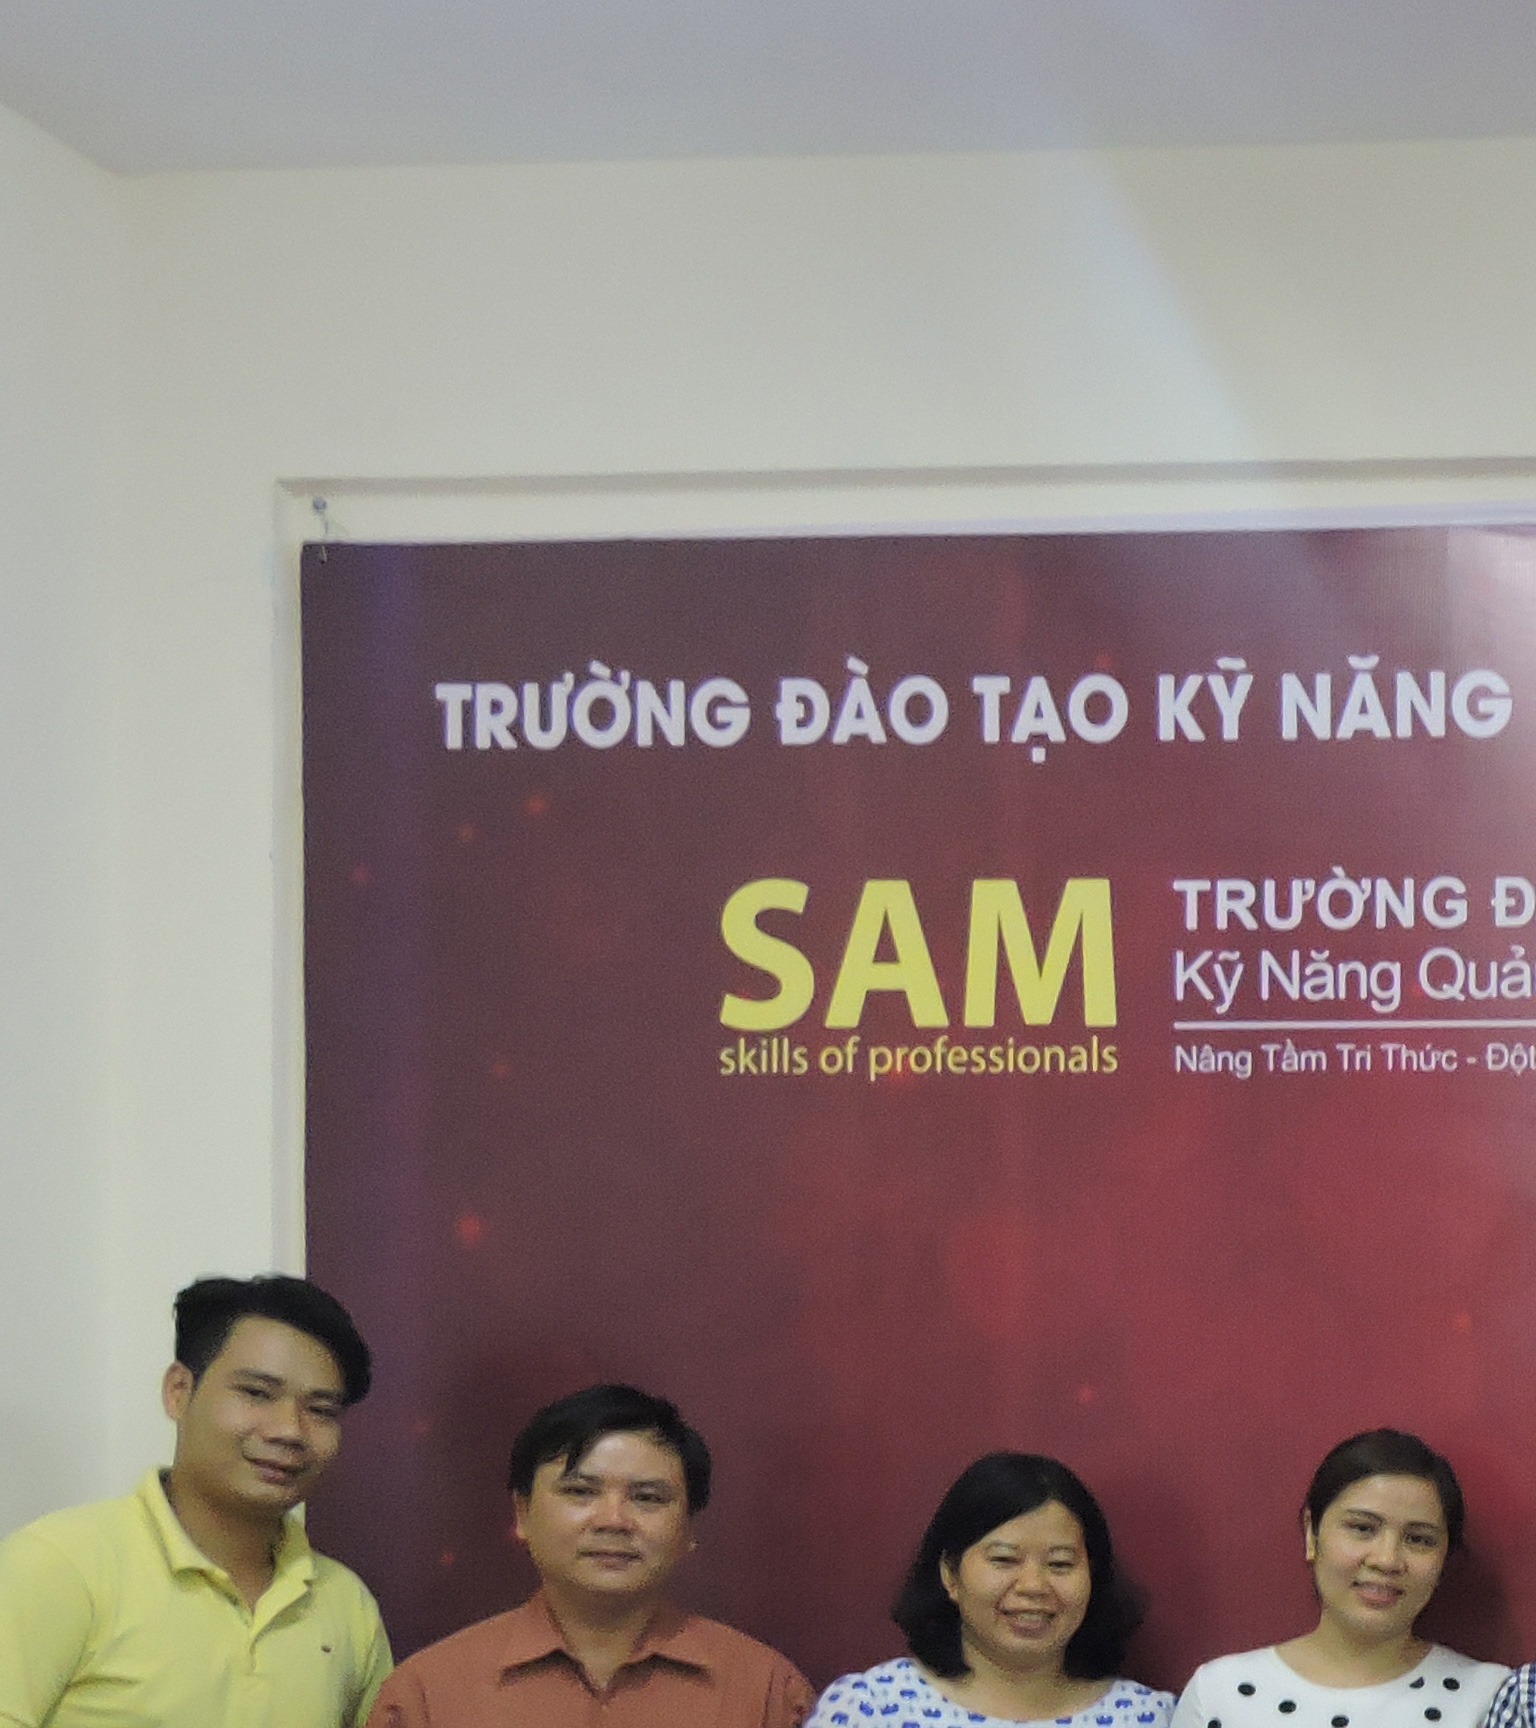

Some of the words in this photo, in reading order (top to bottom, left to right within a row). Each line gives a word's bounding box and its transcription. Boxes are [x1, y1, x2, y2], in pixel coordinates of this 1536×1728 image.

[435, 660, 750, 750] TRƯỜNG
[776, 655, 949, 747] ĐÀO
[973, 674, 1129, 763] TẠO
[1158, 657, 1254, 742] KỸ
[1281, 654, 1512, 740] NĂNG
[1173, 865, 1468, 930] TRƯỜNG
[720, 877, 1117, 1031] SAM
[1173, 949, 1244, 1013] Kỹ
[1259, 948, 1401, 1012] Năng
[720, 1037, 808, 1076] skills
[819, 1035, 860, 1074] of
[869, 1035, 1118, 1081] professionals
[1175, 1041, 1252, 1077] Nâng
[1380, 1039, 1457, 1073] Thức
[1486, 1041, 1536, 1075] Đột
